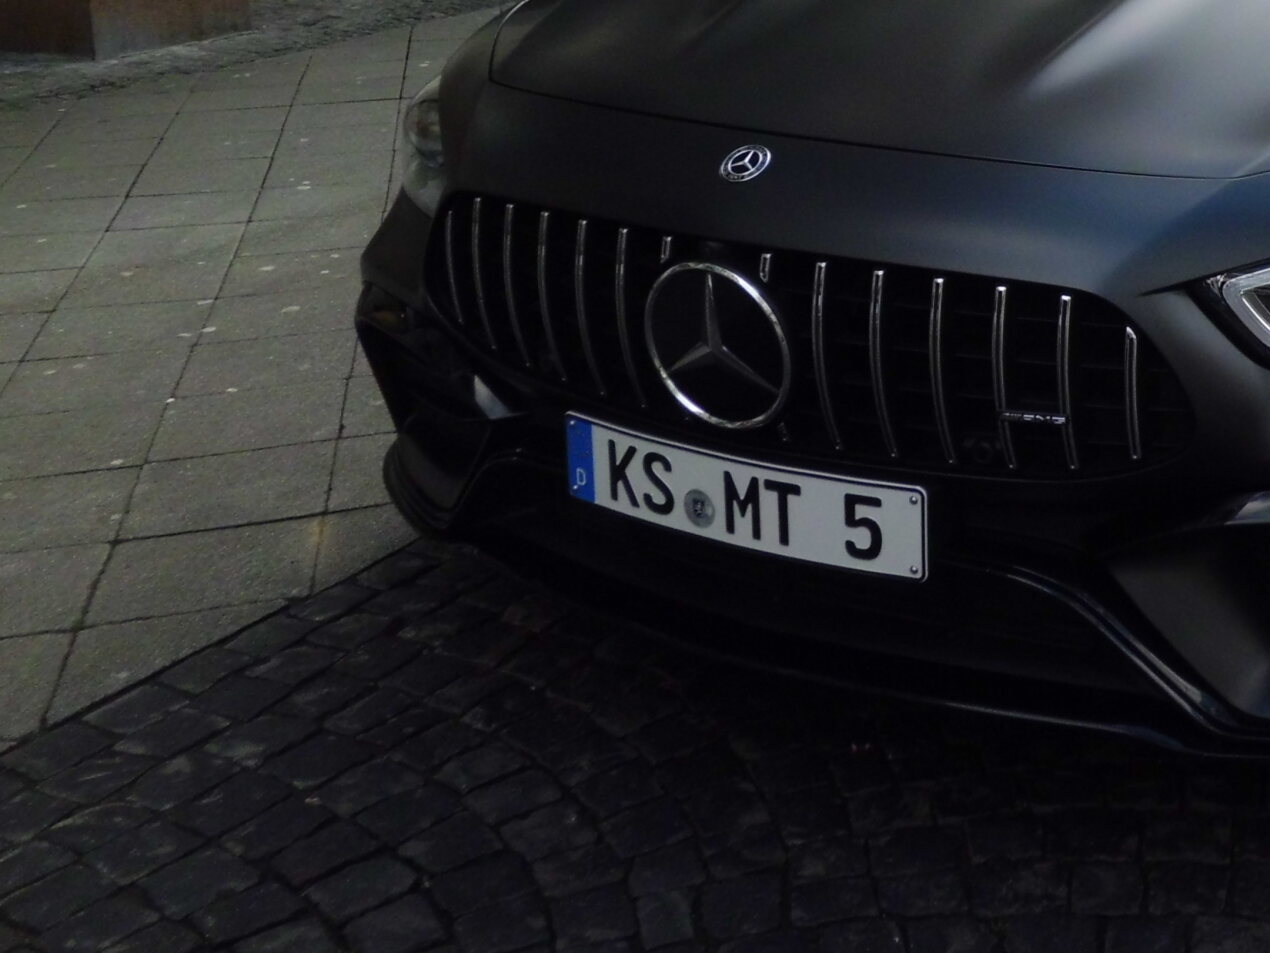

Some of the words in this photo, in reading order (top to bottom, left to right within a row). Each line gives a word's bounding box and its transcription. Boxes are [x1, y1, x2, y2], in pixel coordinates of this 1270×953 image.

[607, 439, 675, 516] KS
[723, 470, 801, 546] MT
[844, 493, 883, 561] 5
